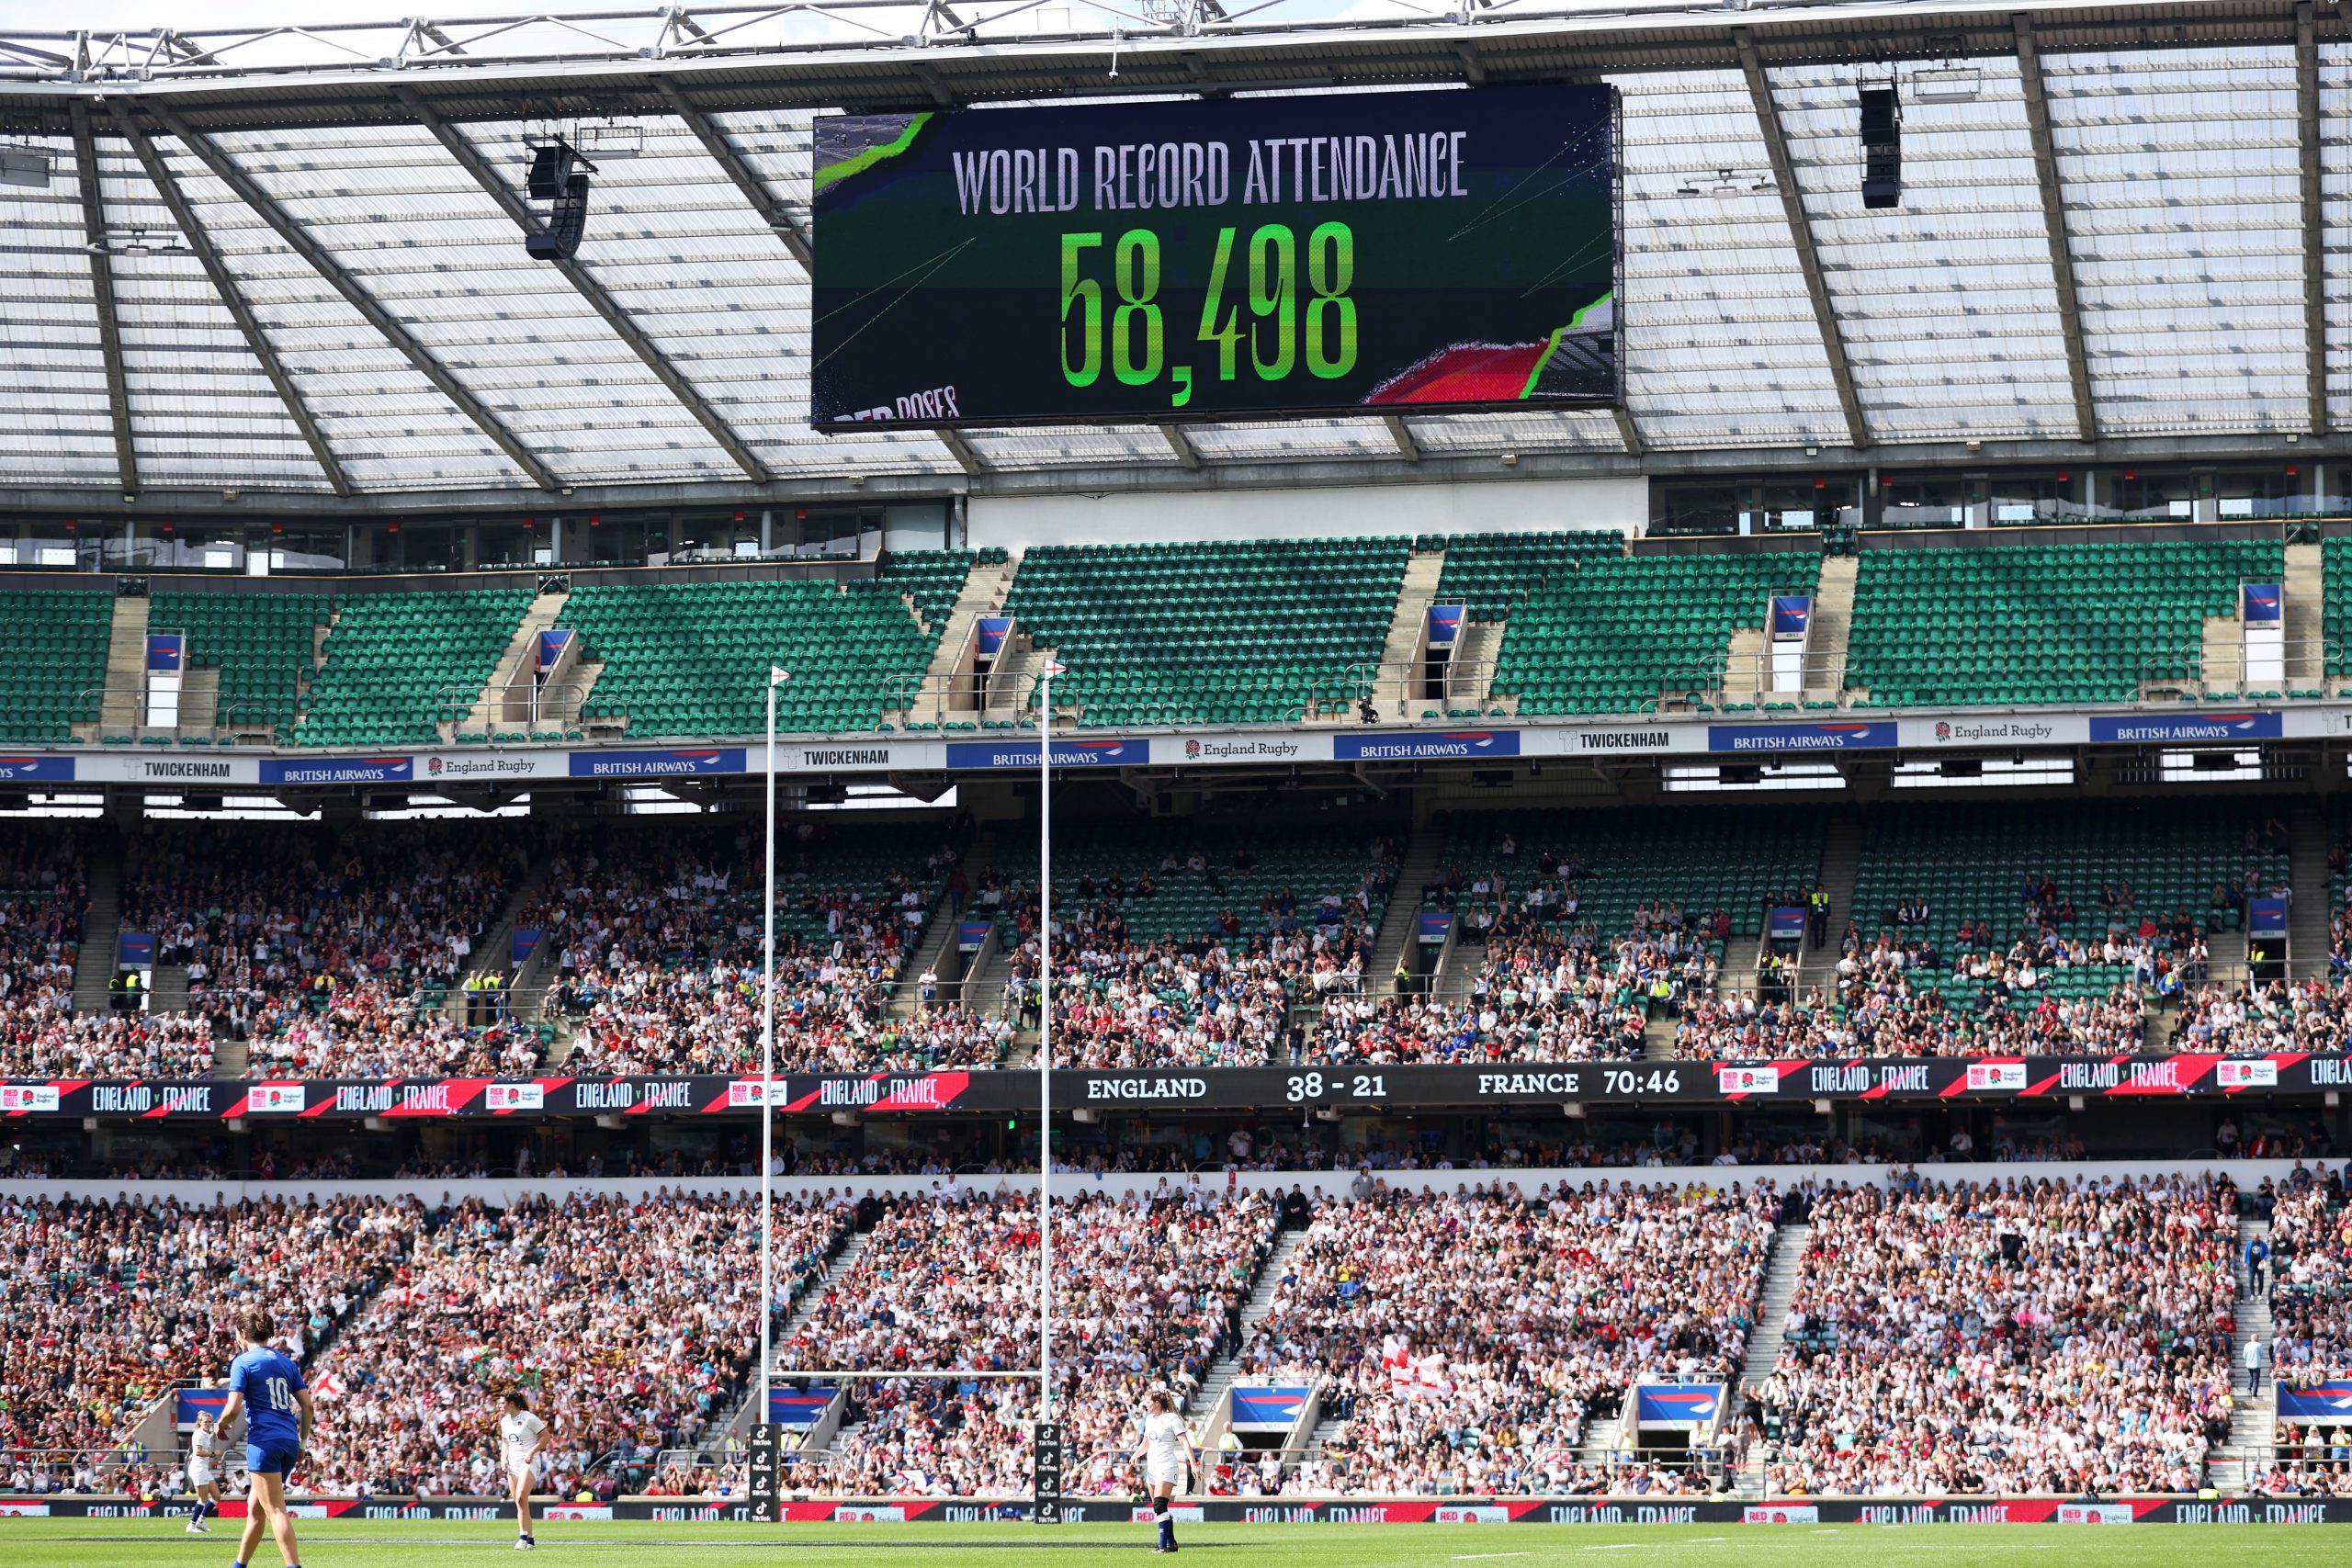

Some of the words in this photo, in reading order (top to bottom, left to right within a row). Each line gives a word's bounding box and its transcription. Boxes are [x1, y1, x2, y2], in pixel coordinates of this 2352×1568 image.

[953, 145, 1079, 216] WORLD
[1095, 138, 1229, 211] RECORD
[1243, 130, 1468, 205] ATTENDANCE
[1060, 220, 1359, 407] 58,498
[1955, 725, 2007, 740] England
[2010, 722, 2052, 739] Rugby
[2117, 727, 2167, 740] BRITISH
[2169, 725, 2228, 738] AIRWAYS
[1204, 742, 1256, 757] England
[1258, 740, 1298, 758] Rugby
[1580, 732, 1669, 749] TWICKENHAM
[1734, 736, 1781, 750] BRITISH
[1782, 734, 1844, 748] AIRWAYS
[804, 750, 889, 765] TWICKENHAM
[993, 753, 1042, 765] BRITISH
[1360, 745, 1412, 759] BRITISH
[1413, 743, 1468, 757] AIRWAYS
[144, 761, 231, 779] TWICKENHAM
[284, 769, 331, 782] BRITISH
[333, 767, 384, 781] AIRWAYS
[446, 760, 495, 775] England
[497, 759, 536, 774] Rugby
[593, 761, 642, 774] BRITISH
[644, 760, 695, 773] AIRWAYS
[1812, 1066, 1870, 1092] ENGLAND
[1882, 1065, 1929, 1090] FRANCE
[2061, 1063, 2119, 1089] ENGLAND
[2131, 1062, 2179, 1088] FRANCE
[2311, 1058, 2352, 1085] ENGLA
[1087, 1078, 1206, 1100] ENGLAND
[1286, 1072, 1323, 1101] 38
[1352, 1075, 1386, 1097] 21
[1478, 1073, 1579, 1094] FRANCE
[1603, 1069, 1679, 1094] 70:46
[93, 1087, 151, 1111] ENGLAND
[163, 1087, 211, 1111] FRANCE
[336, 1085, 392, 1111] ENGLAND
[404, 1085, 450, 1110] FRANCE
[490, 1088, 503, 1096] RED
[576, 1083, 632, 1109] ENGLAND
[645, 1082, 691, 1108] FRANCE
[820, 1079, 878, 1105] ENGLAND
[889, 1078, 937, 1104] FRANCE
[266, 1377, 288, 1410] 10
[1136, 1511, 1155, 1521] RED
[1440, 1511, 1458, 1521] RED
[1749, 1511, 1768, 1521] RED
[2062, 1509, 2081, 1518] RED
